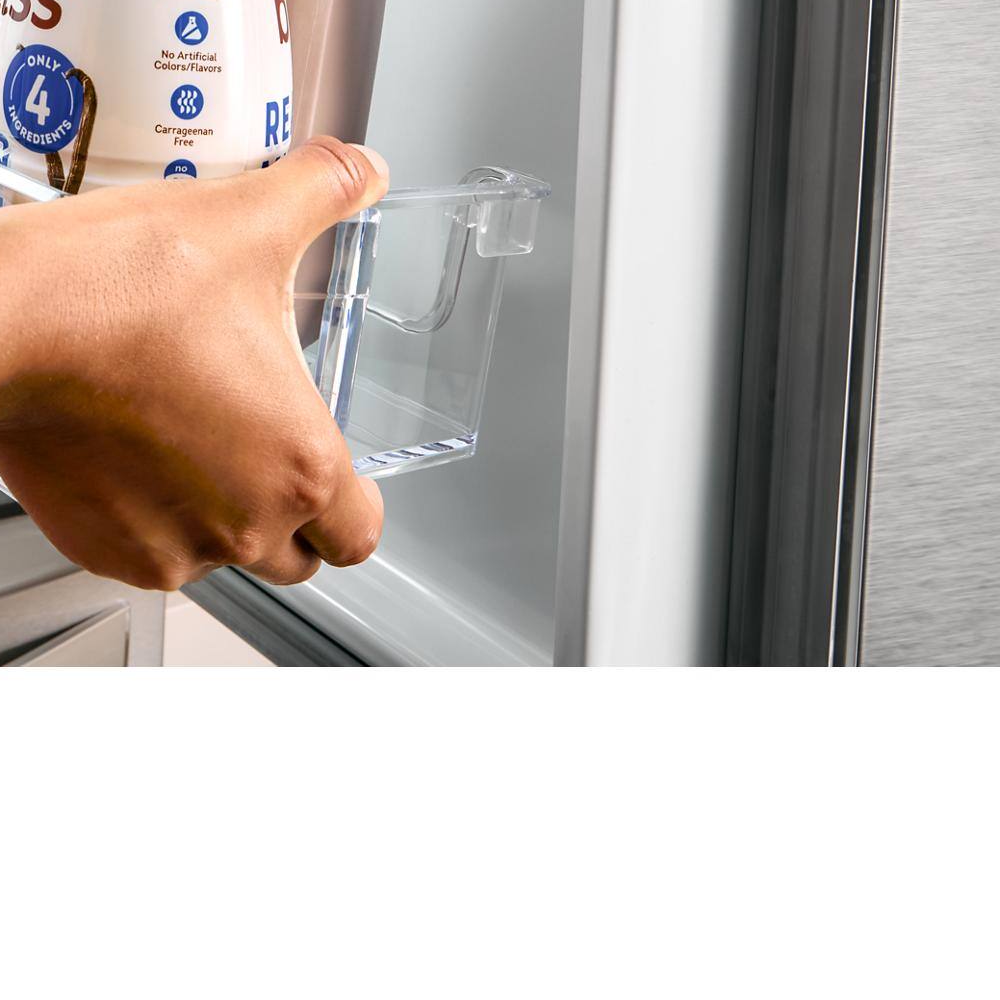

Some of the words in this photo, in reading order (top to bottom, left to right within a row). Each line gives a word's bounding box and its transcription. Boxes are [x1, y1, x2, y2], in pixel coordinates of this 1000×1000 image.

[161, 50, 175, 59] No
[177, 51, 217, 62] Artificial
[27, 54, 61, 72] ONLY
[154, 60, 222, 73] Colors/Flavors
[25, 74, 51, 126] 4
[8, 104, 73, 145] INGREDIENTS
[155, 124, 213, 138] Carrageenan
[174, 137, 194, 147] Free
[175, 165, 188, 173] no
